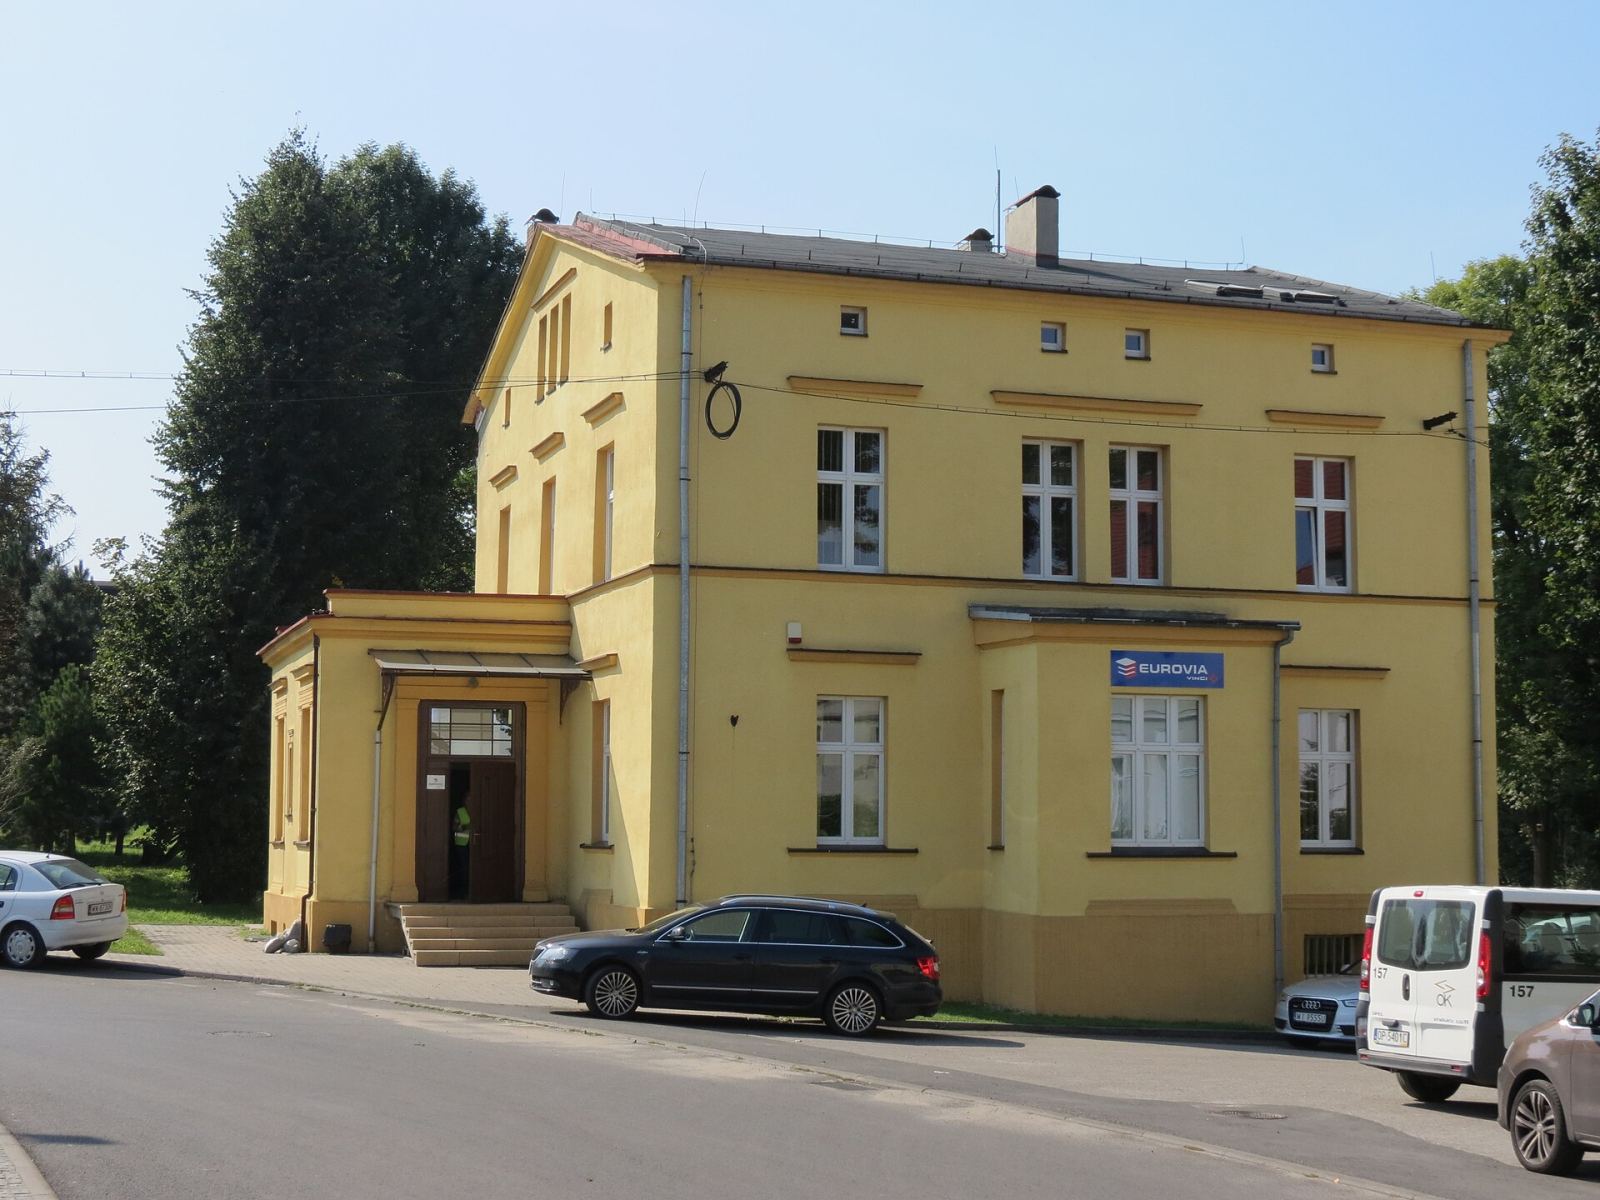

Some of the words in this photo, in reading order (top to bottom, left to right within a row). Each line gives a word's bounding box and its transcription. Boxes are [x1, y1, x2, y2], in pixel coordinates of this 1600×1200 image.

[1139, 663, 1208, 675] EUROVIA
[1373, 967, 1388, 979] 157
[1510, 984, 1535, 998] 157
[1436, 993, 1453, 1009] OK
